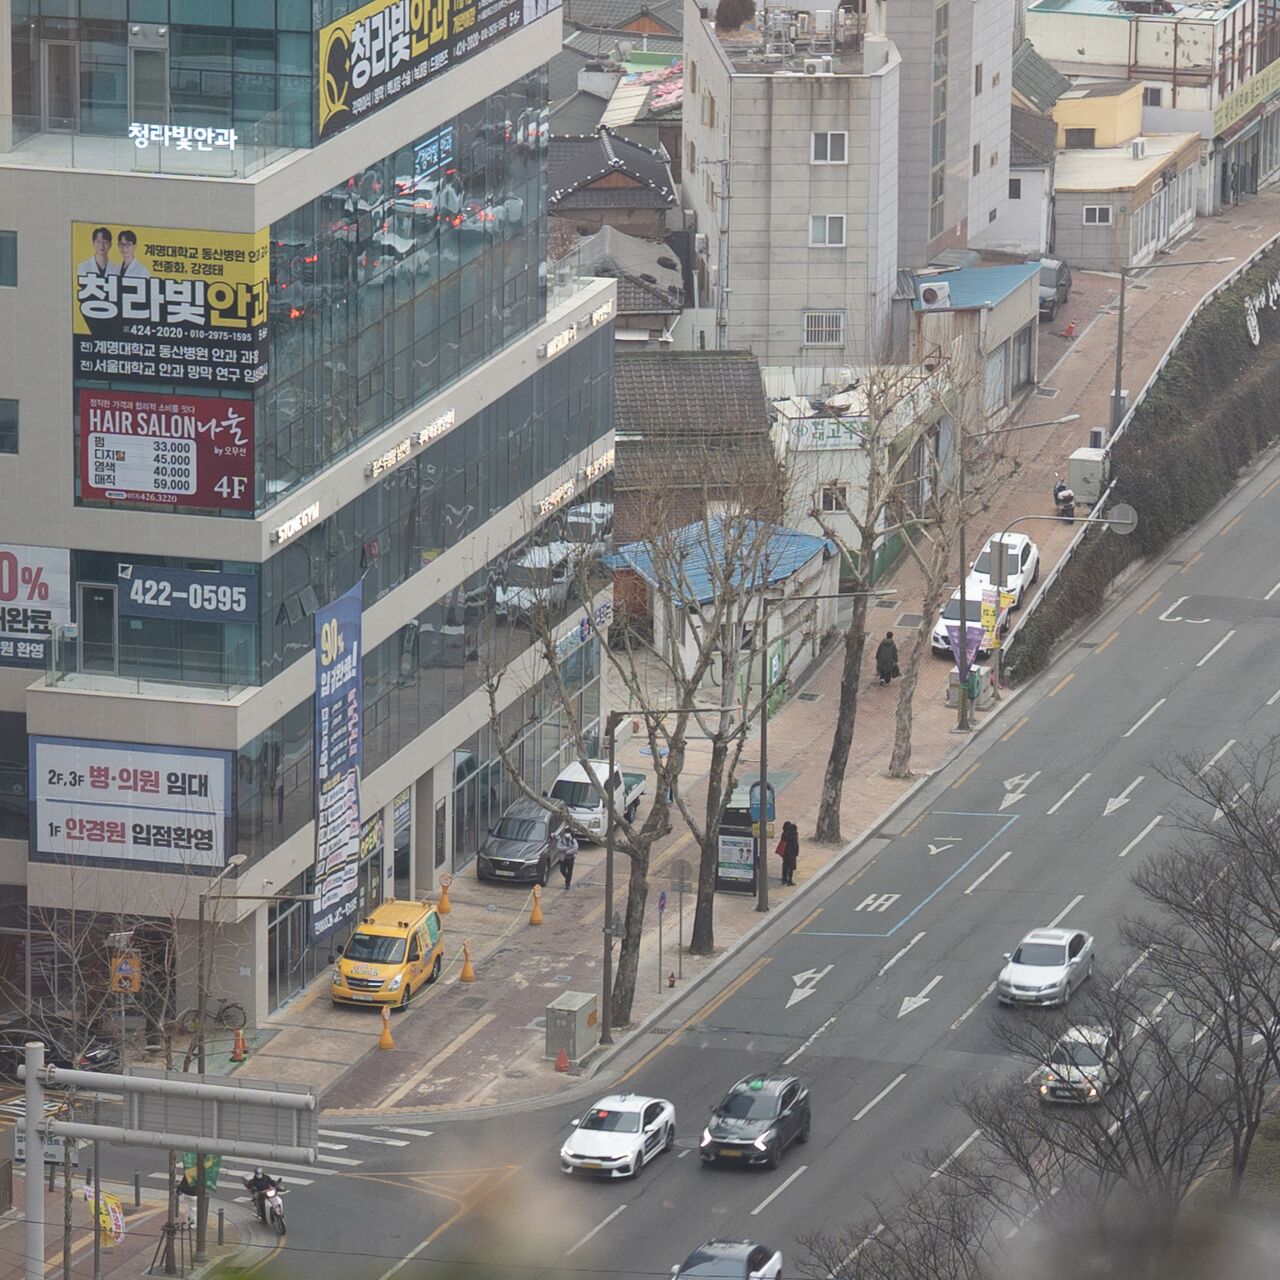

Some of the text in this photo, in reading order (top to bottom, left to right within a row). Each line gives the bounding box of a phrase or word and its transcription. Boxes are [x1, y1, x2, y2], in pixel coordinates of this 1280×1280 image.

[128, 123, 238, 151] 청라빛안과
[144, 243, 199, 259] 계명대학교
[201, 248, 245, 263] 동산병원
[77, 272, 268, 328] 청라빛안과
[130, 325, 183, 337] 424-2020
[190, 329, 252, 342] 010-2975-1595
[94, 341, 155, 357] 계명대학교
[159, 345, 208, 361] 동산병원
[212, 348, 237, 362] 안과
[94, 359, 155, 376] 서울대학교
[159, 363, 184, 378] 안과
[187, 366, 213, 380] 망막
[216, 367, 240, 381] 연구
[89, 409, 133, 433] HAIR
[137, 413, 196, 438] SALON
[153, 441, 190, 453] 33,000
[153, 454, 190, 466] 45,000
[94, 474, 190, 491] 매직 59,000
[153, 466, 190, 478] 40,000
[214, 475, 248, 499] 4F
[130, 578, 247, 612] 422-0595
[17, 642, 44, 659] 환영
[48, 765, 208, 797] 2F,3F 병·의원 임대
[48, 817, 213, 851] 1F 안경원 입점환영
